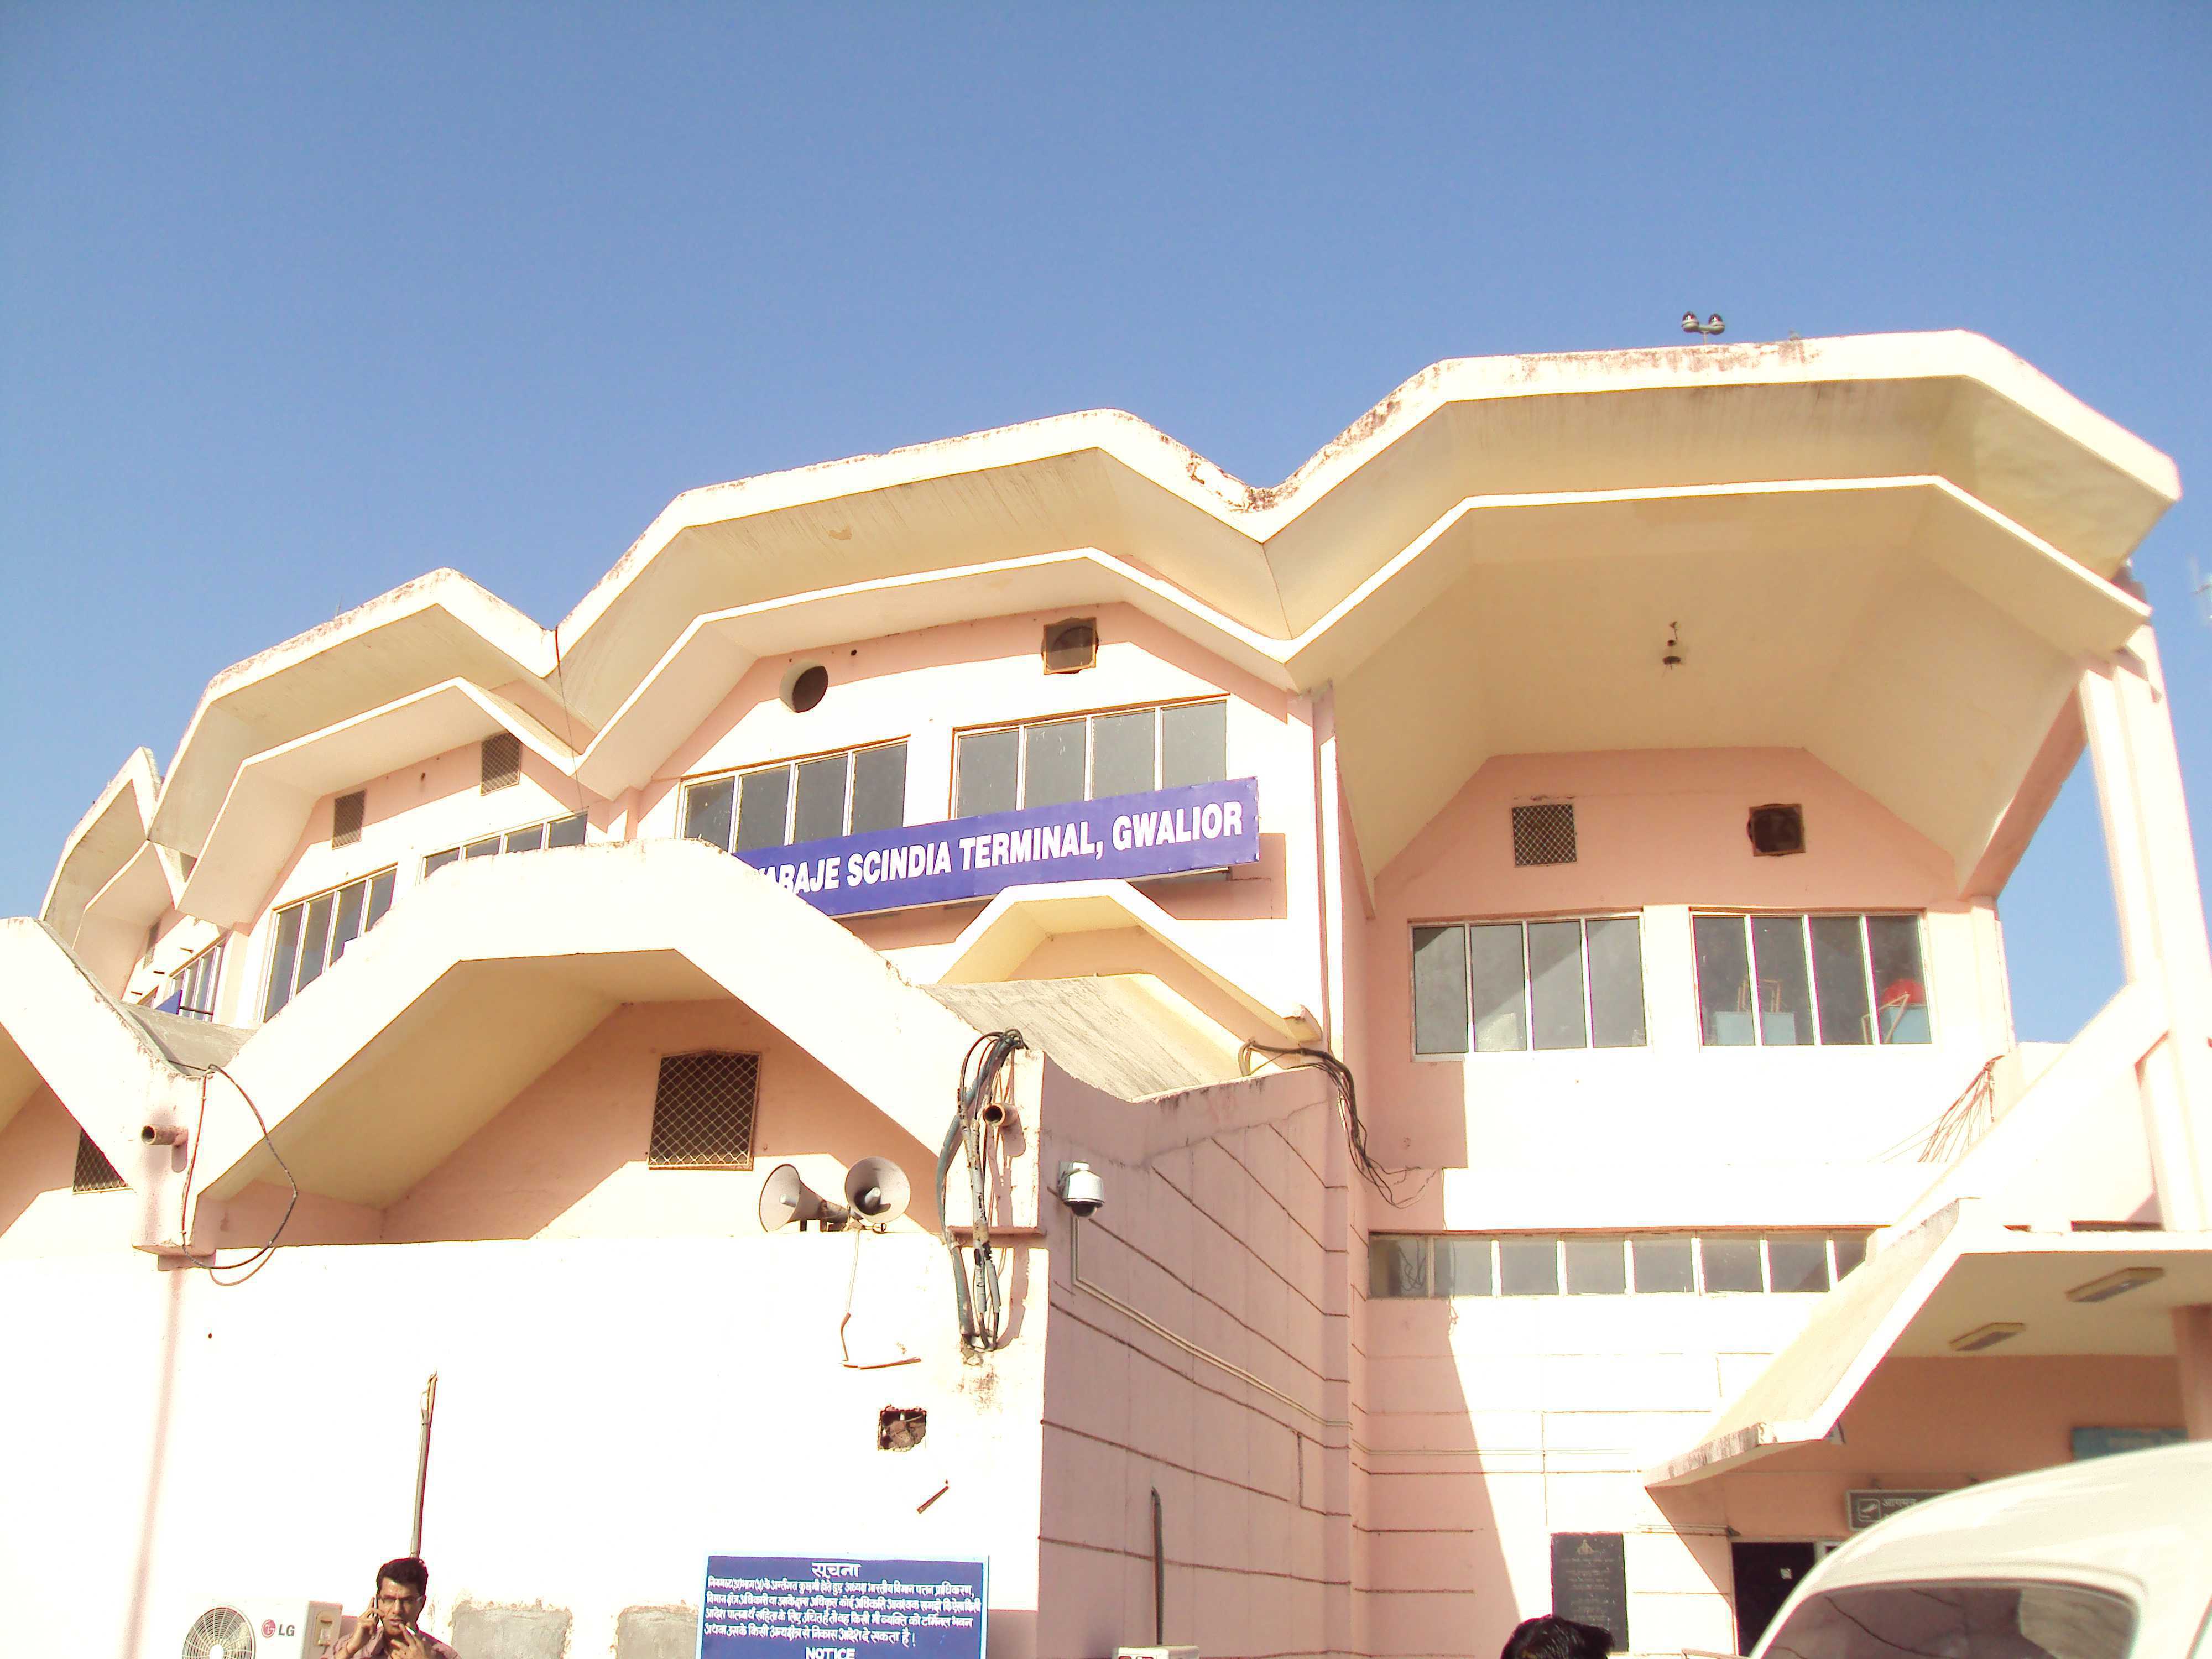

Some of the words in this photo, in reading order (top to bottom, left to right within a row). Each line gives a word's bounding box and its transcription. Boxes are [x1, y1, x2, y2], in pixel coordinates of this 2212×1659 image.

[758, 856, 841, 894] ARAJE
[847, 839, 952, 887] SCINDIA
[958, 821, 1104, 872] TERMINAL,
[1112, 800, 1243, 852] GWALIOR
[811, 1562, 862, 1579] सूचना
[705, 1606, 726, 1620] आदेश
[802, 1609, 823, 1624] उचित
[872, 1611, 881, 1624] भी
[909, 1612, 921, 1626] को
[278, 1624, 295, 1637] LG
[870, 1631, 900, 1644] सकता
[805, 1647, 856, 1659] NOTICE
